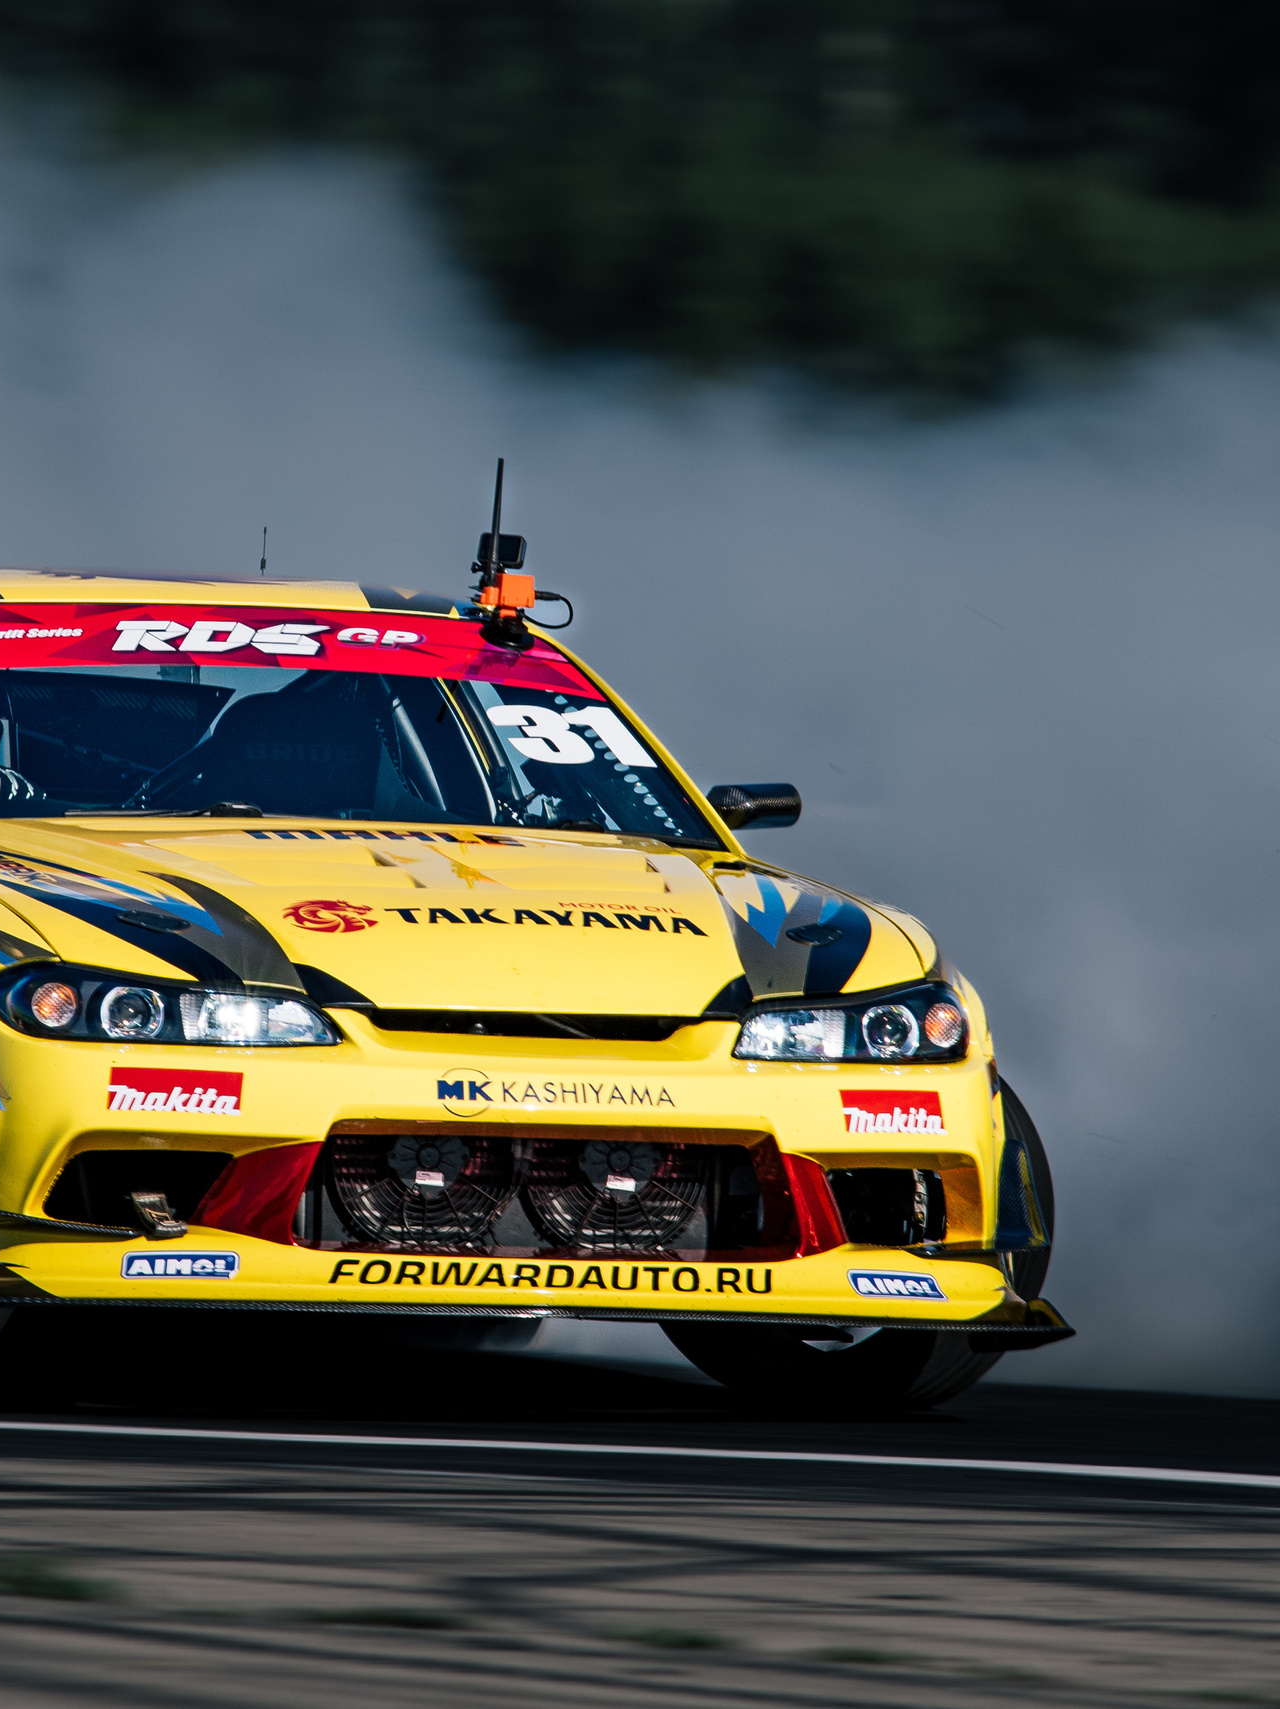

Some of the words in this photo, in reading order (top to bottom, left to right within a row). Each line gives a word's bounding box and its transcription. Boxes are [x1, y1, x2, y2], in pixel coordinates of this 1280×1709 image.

[27, 627, 83, 639] Series
[111, 620, 330, 655] RDS
[337, 627, 423, 650] GP
[487, 705, 657, 767] 31
[384, 907, 709, 937] TAKAYAMA
[558, 902, 634, 912] MOTOR
[639, 905, 682, 914] OIL
[437, 1077, 494, 1102] MK
[501, 1081, 677, 1110] KASHIYAMA
[127, 1258, 228, 1276] AIMOL
[328, 1258, 774, 1296] FORWARDAUTO.RU
[857, 1277, 934, 1298] AIMOL
